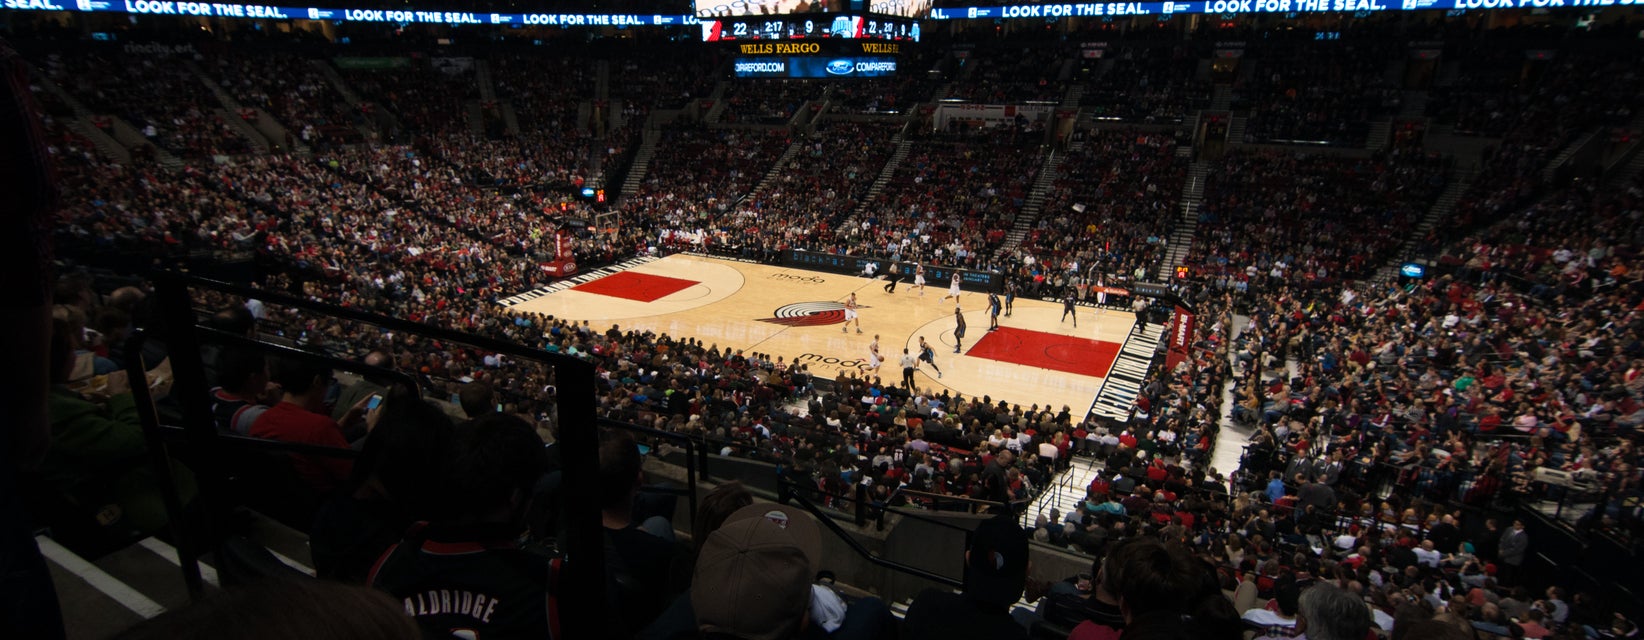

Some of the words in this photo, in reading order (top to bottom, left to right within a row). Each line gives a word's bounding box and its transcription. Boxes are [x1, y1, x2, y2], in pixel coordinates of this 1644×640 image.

[124, 0, 176, 14] LOOK
[177, 1, 212, 16] FOR
[212, 3, 245, 17] THE
[246, 5, 288, 19] SEAL.
[1001, 5, 1040, 17] LOOK
[1043, 4, 1073, 16] FOR
[1075, 3, 1104, 15] THE
[1106, 2, 1150, 15] SEAL.
[1204, 0, 1250, 13] LOOK
[1254, 0, 1292, 12] FOR
[1295, 0, 1330, 11] THE
[1332, 0, 1387, 11] SEAL.
[345, 9, 385, 22] LOOK
[386, 10, 414, 22] FOR
[416, 11, 443, 23] THE
[445, 12, 482, 24] SEAL.
[523, 13, 559, 25] LOOK
[560, 14, 585, 25] FOR
[586, 14, 610, 25] THE
[611, 14, 645, 25] SEAL.
[733, 22, 747, 35] 22
[764, 21, 783, 32] 2:17
[805, 20, 814, 33] 9
[868, 21, 877, 34] 22
[900, 24, 906, 35] 9
[740, 43, 773, 54] WELLS
[775, 42, 820, 54] FARGO
[861, 43, 892, 54] WELLS
[771, 273, 825, 284] moda
[497, 280, 577, 307] PORTLAND
[573, 268, 612, 285] TRAIL
[1111, 354, 1152, 380] TRAIL
[1092, 377, 1141, 422] BLAZERS
[404, 589, 499, 623] ALDRIDGE
